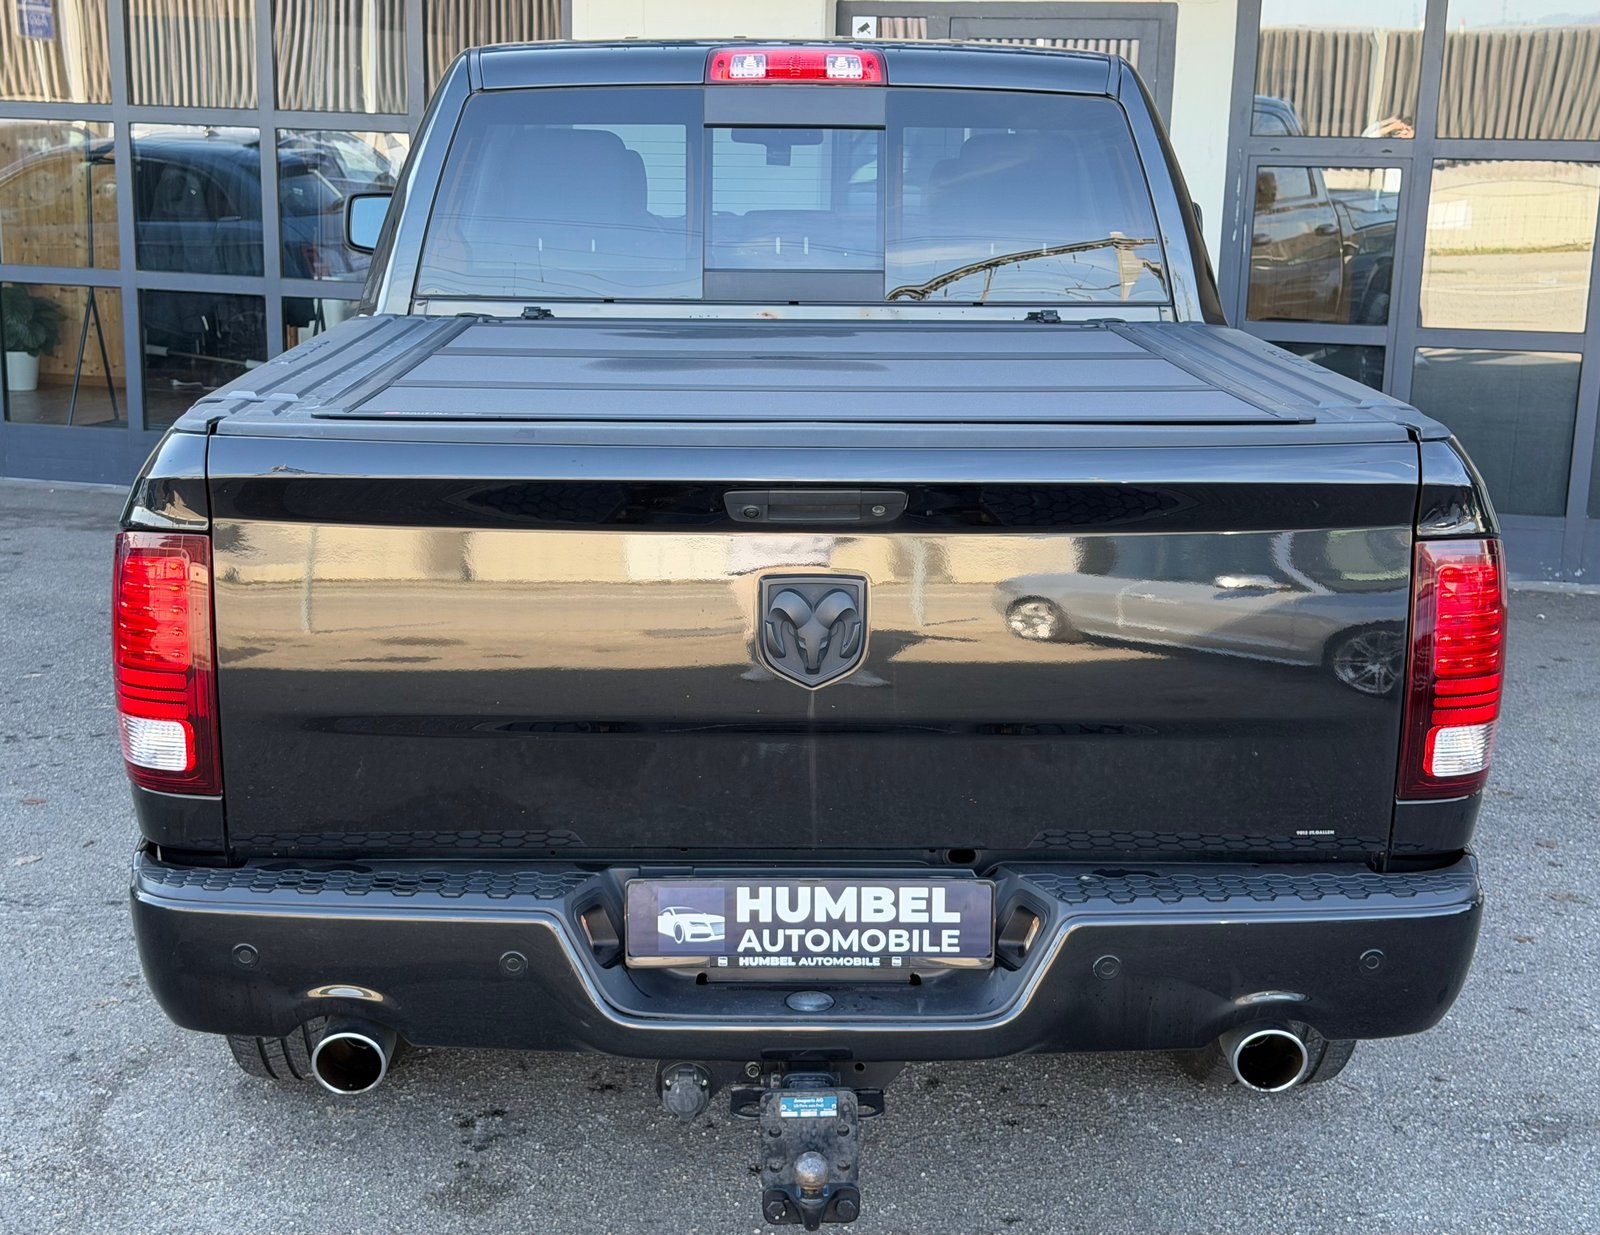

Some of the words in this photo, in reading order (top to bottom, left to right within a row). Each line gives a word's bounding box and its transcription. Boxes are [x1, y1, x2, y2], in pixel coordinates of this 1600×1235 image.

[736, 886, 961, 923] HUMBEL
[736, 928, 961, 953] AUTOMOBILE
[739, 956, 796, 967] HUMBEL
[798, 956, 881, 967] AUTOMOBILE
